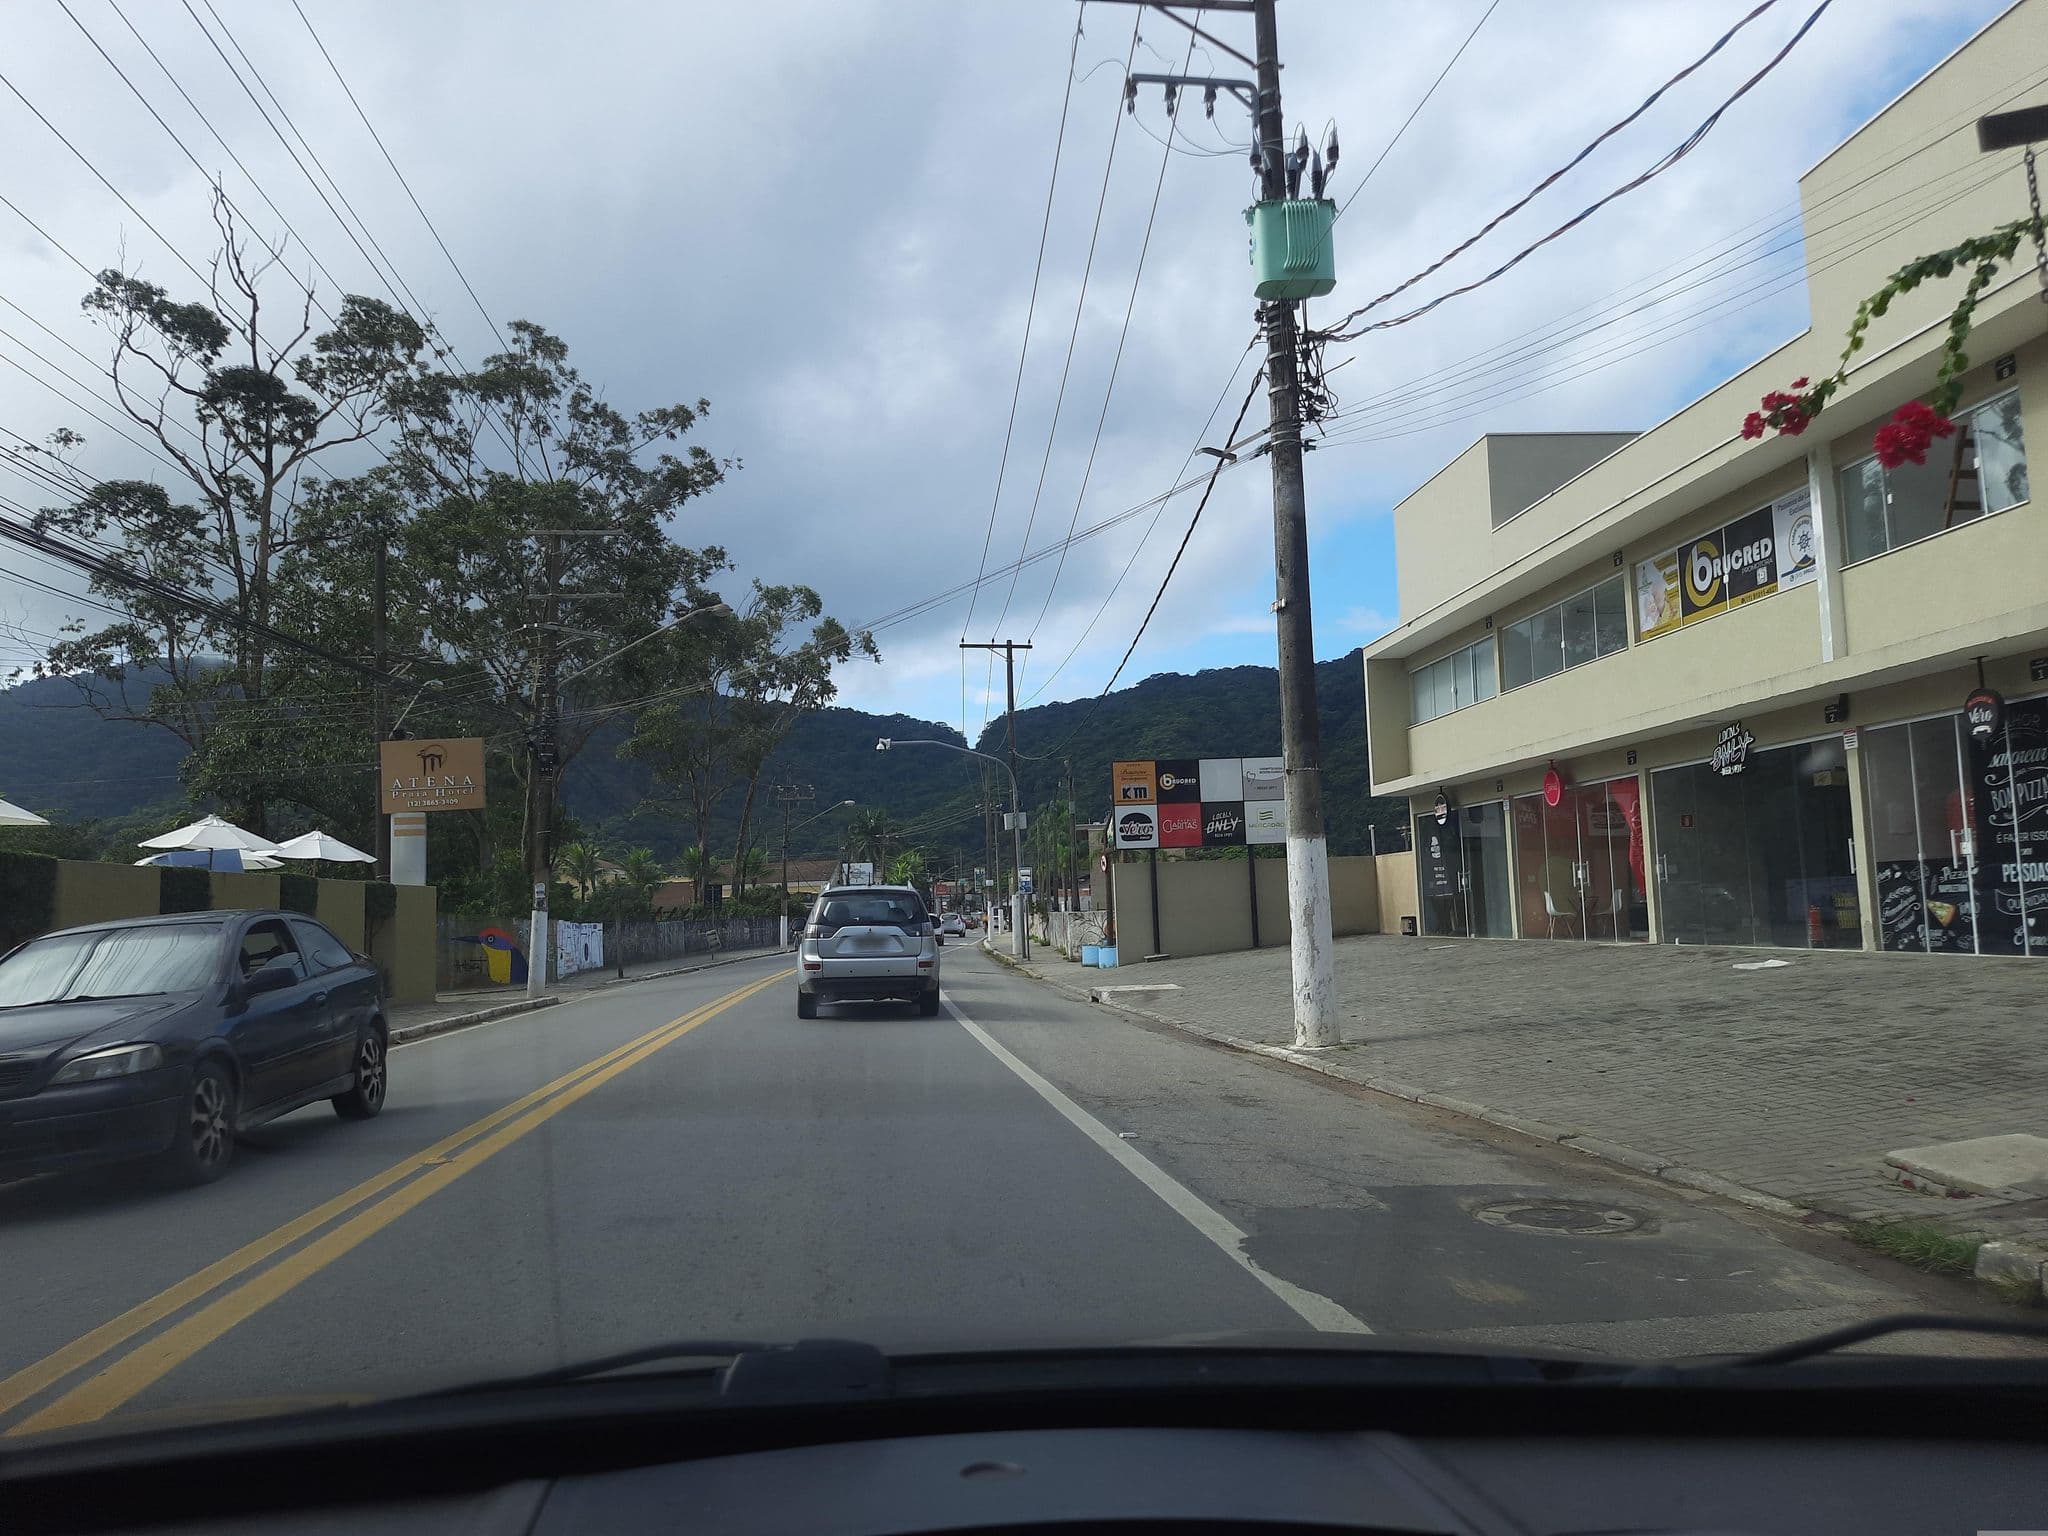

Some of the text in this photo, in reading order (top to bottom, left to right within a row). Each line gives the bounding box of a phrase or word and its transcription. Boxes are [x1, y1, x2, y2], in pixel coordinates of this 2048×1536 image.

[392, 775, 473, 789] ATENA
[436, 786, 474, 797] Hotel
[1212, 811, 1233, 821] LOCALS
[1205, 816, 1240, 835] ONLY
[2002, 862, 2048, 883] PESOA
